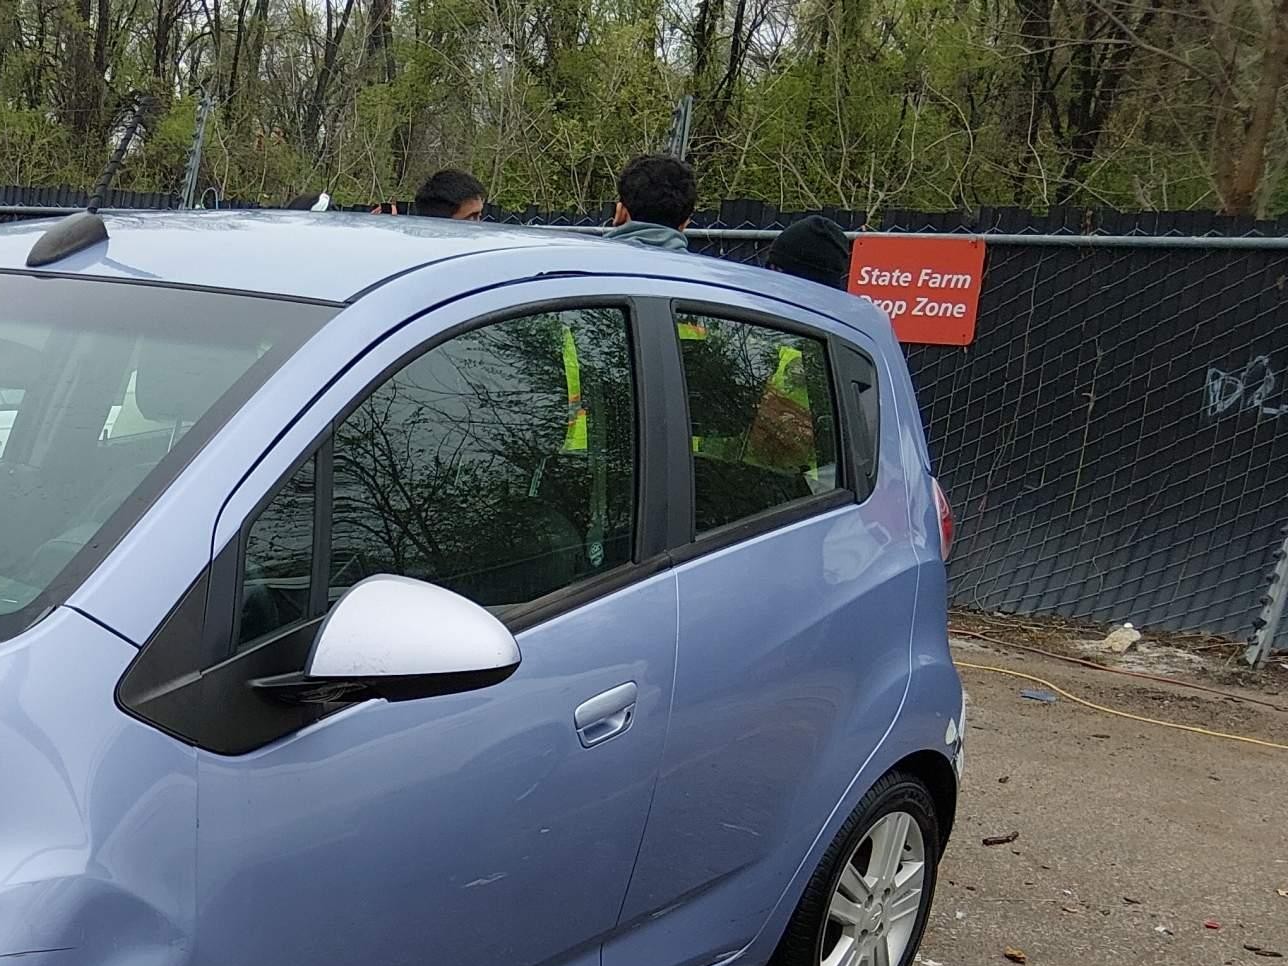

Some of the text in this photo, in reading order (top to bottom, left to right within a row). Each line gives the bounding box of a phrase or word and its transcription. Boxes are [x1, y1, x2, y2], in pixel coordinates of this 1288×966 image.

[857, 266, 972, 289] State Farm
[911, 297, 966, 318] Zone
